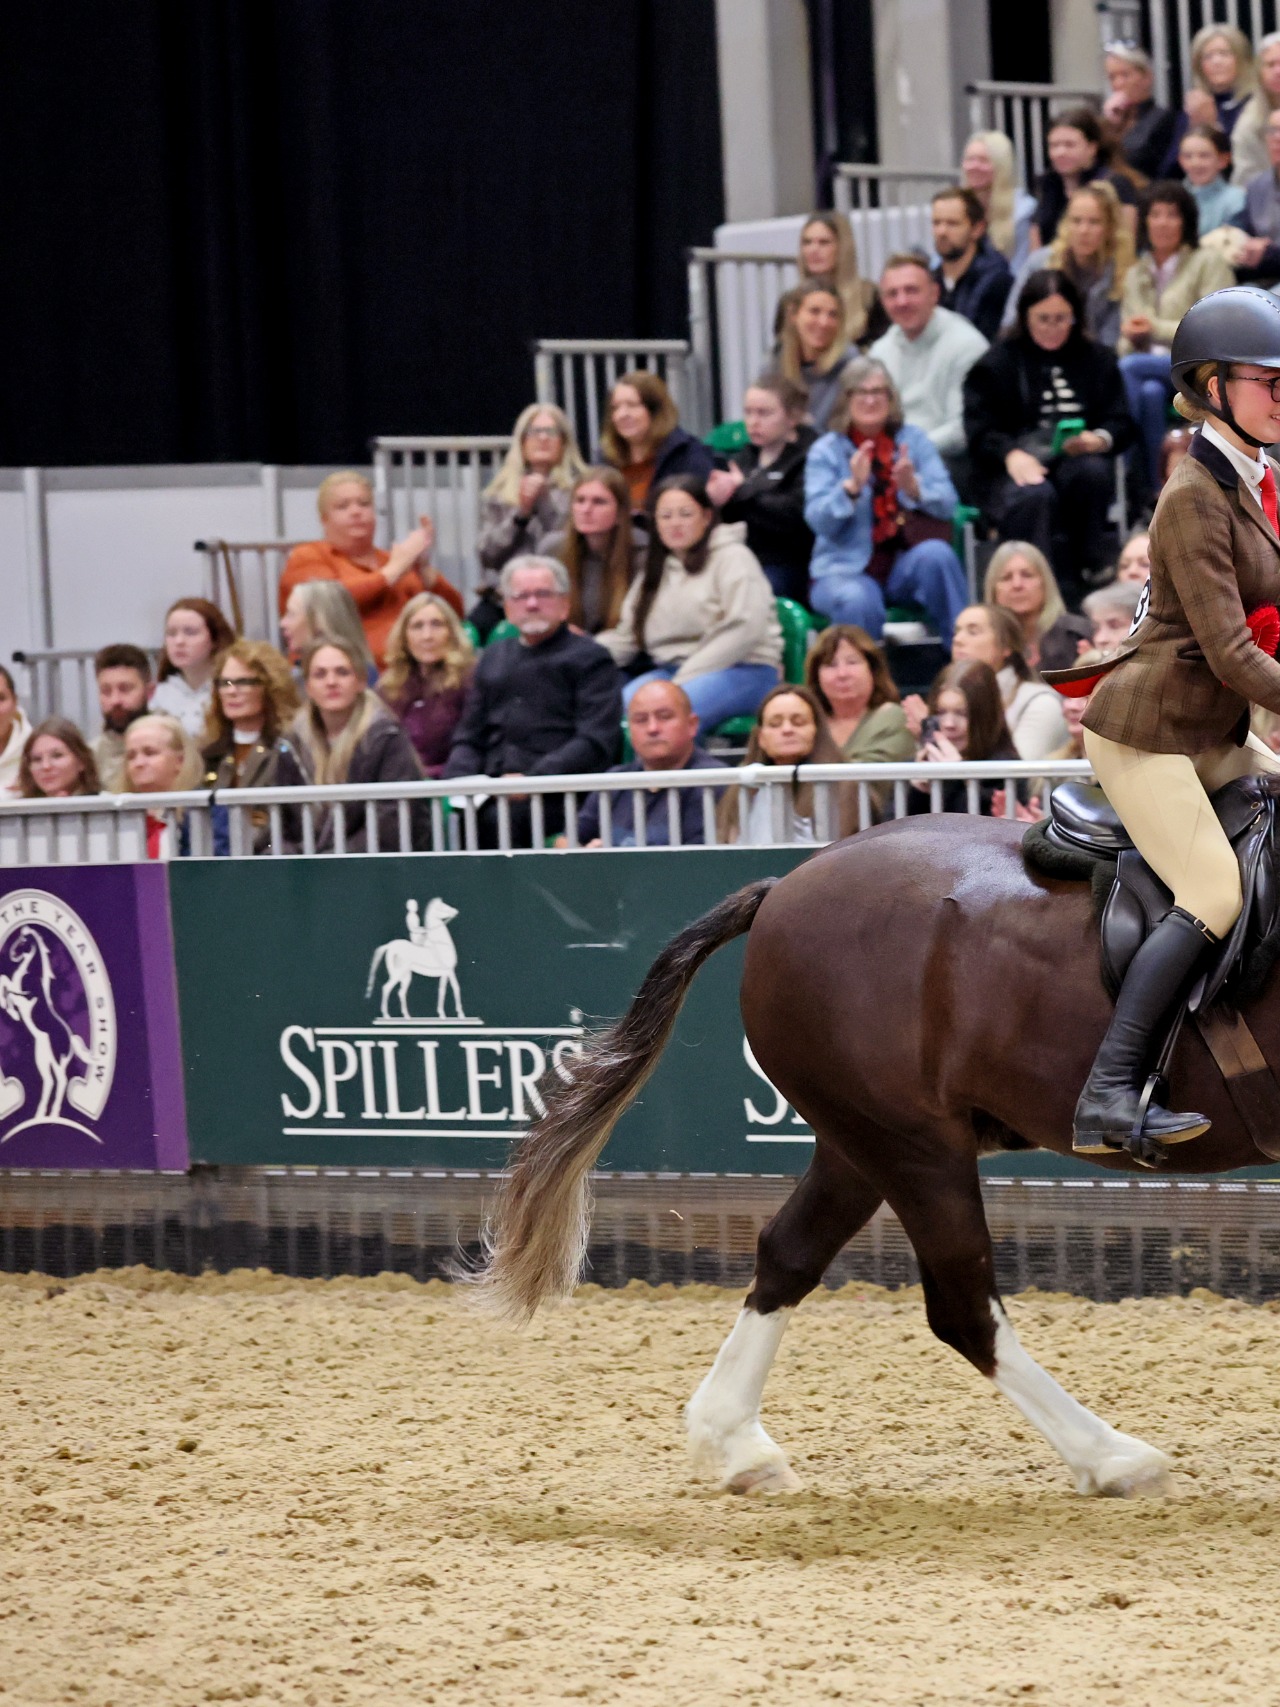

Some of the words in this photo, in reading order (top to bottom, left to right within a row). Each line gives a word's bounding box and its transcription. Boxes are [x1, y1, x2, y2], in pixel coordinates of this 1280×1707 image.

[0, 901, 39, 924] THE
[53, 910, 97, 974] YEAR
[95, 996, 109, 1083] SHOW
